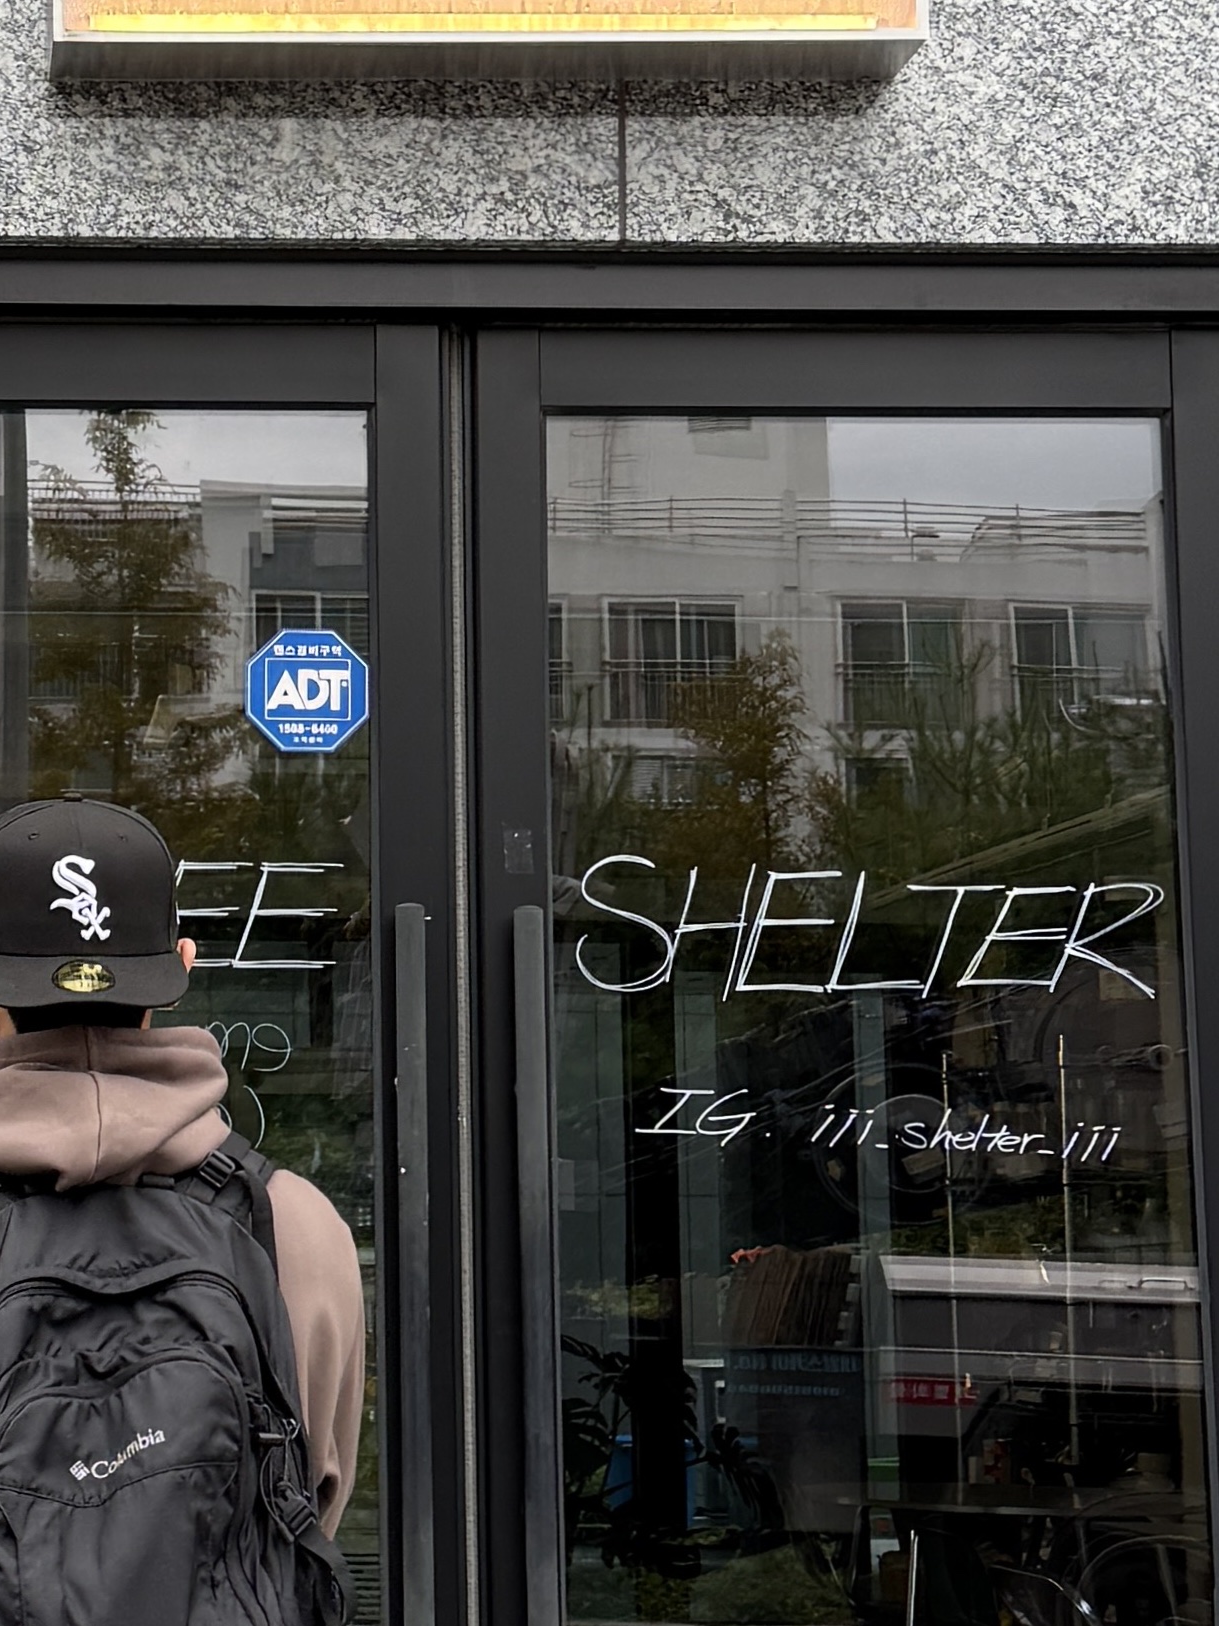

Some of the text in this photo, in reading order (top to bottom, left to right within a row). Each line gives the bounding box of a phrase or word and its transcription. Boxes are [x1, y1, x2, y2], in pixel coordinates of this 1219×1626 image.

[266, 668, 349, 711] ADT
[575, 853, 1165, 1001] SHELTER
[90, 1428, 166, 1479] Columbia
